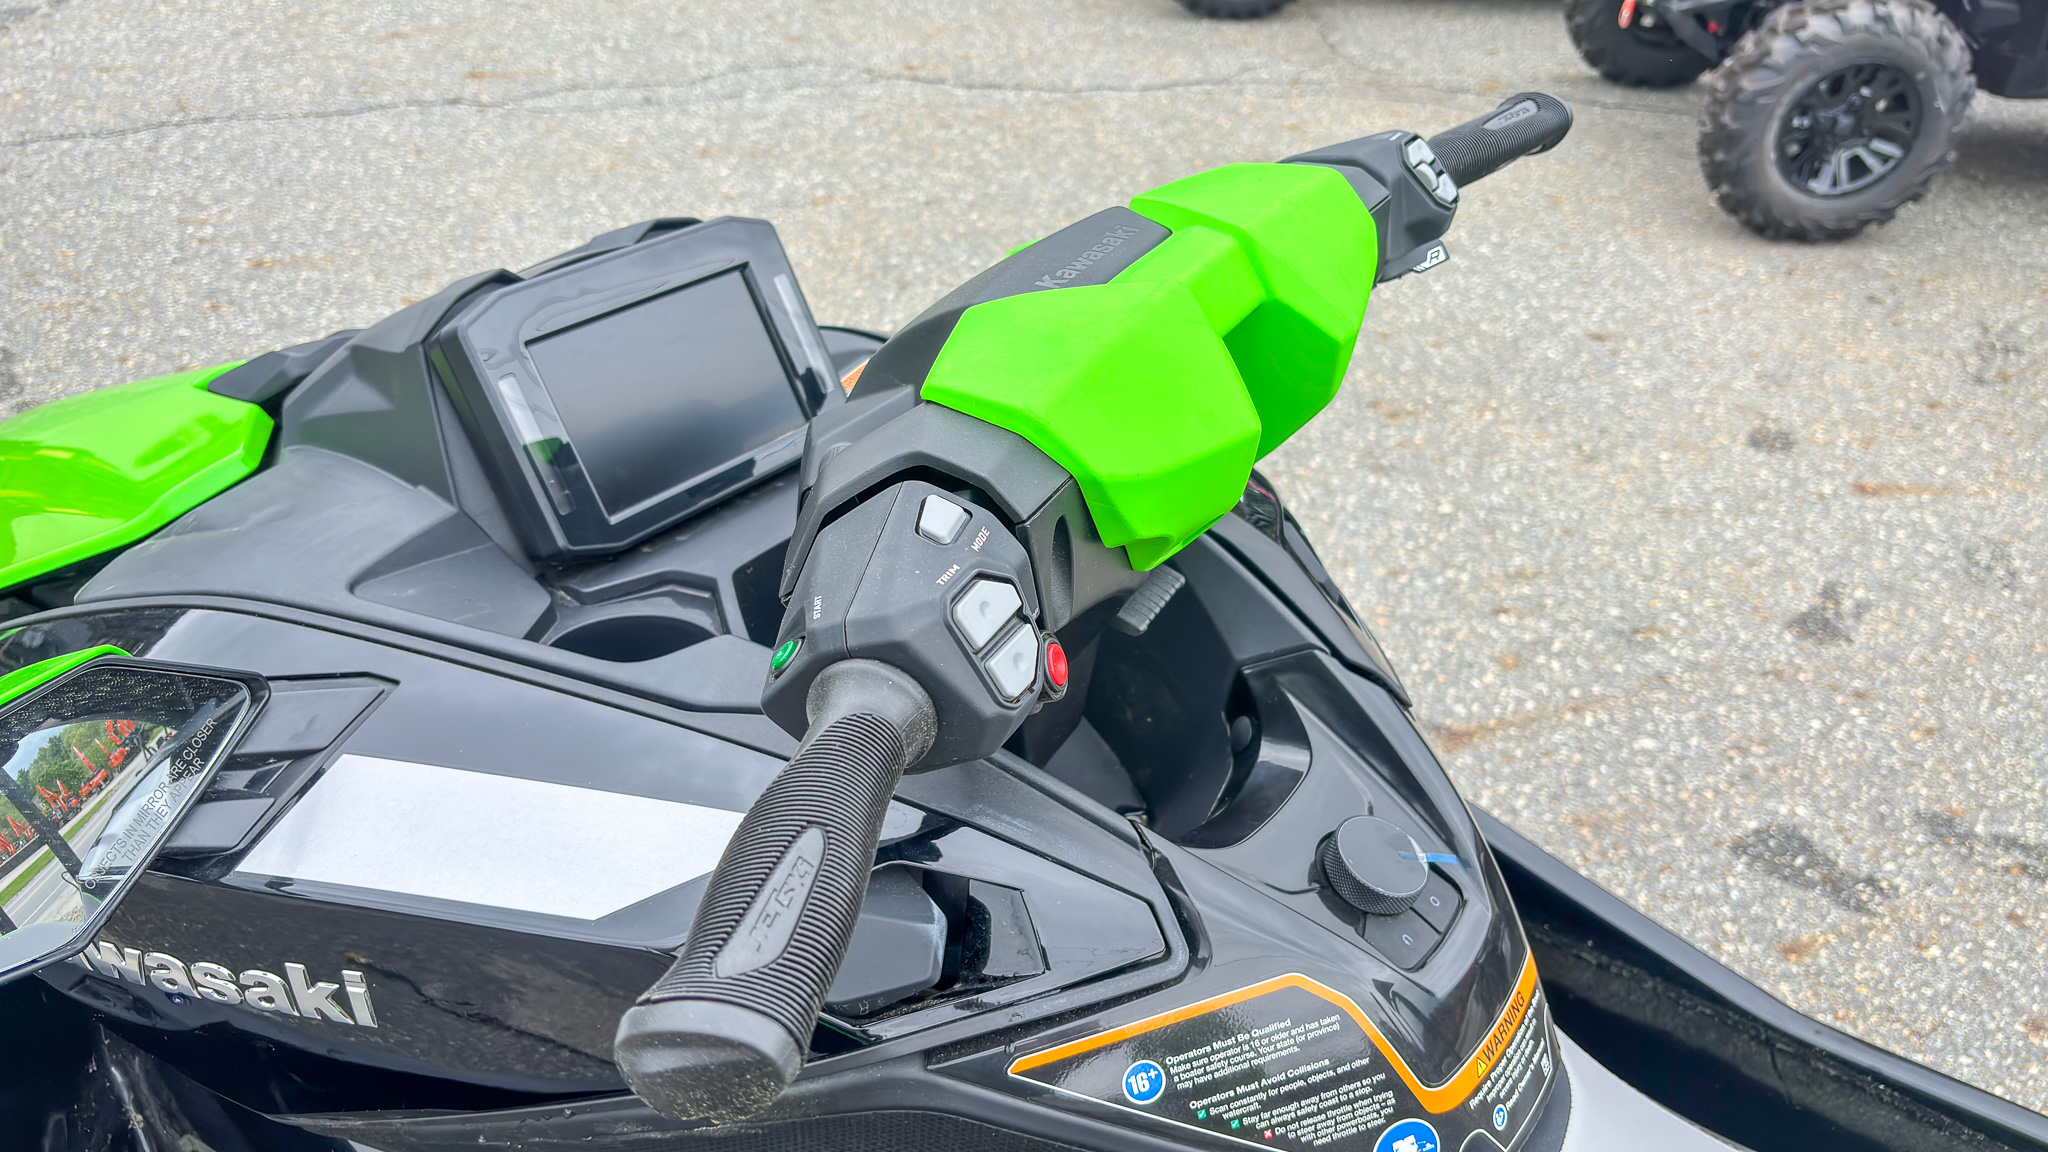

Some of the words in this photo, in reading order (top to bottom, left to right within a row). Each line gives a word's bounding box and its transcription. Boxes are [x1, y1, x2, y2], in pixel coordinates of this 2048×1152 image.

[1034, 223, 1140, 289] Kawasaki
[970, 525, 991, 553] MODE
[935, 563, 960, 587] TRIM
[812, 594, 823, 621] START
[85, 837, 128, 889] OBJECTS
[123, 824, 138, 840] IN
[132, 781, 169, 825] MIRROR
[166, 758, 188, 785] ARE
[183, 717, 218, 761] CLOSER
[121, 831, 151, 863] THAN
[145, 799, 172, 831] THEY
[170, 757, 205, 803] APPEAR
[78, 940, 379, 1028] wasaki
[1165, 1046, 1210, 1065] Operators
[1212, 1036, 1236, 1050] Must
[1237, 1033, 1250, 1042] Be
[1251, 1018, 1291, 1037] Qualified
[1169, 1063, 1191, 1075] Make
[1192, 1057, 1209, 1067] sure
[1209, 1046, 1241, 1062] operator
[1242, 1043, 1250, 1051] is
[1249, 1039, 1260, 1048] 16
[1261, 1037, 1269, 1045] or
[1270, 1031, 1289, 1042] older
[1290, 1024, 1305, 1035] and
[1305, 1021, 1319, 1031] has
[1319, 1014, 1340, 1026] taken
[1482, 991, 1525, 1062] WARNING
[1177, 1079, 1193, 1090] may
[1194, 1073, 1213, 1084] have
[1213, 1061, 1250, 1077] additional
[1250, 1044, 1300, 1066] requirements.
[1179, 1067, 1204, 1080] boater
[1205, 1059, 1228, 1072] safety
[1229, 1049, 1257, 1064] course.
[1257, 1044, 1275, 1055] Your
[1276, 1038, 1295, 1049] state
[1295, 1034, 1305, 1043] (or
[1307, 1022, 1340, 1040] province)
[1469, 1080, 1492, 1110] Require
[1490, 1056, 1507, 1082] Proper
[1506, 1022, 1526, 1058] Operation
[1127, 1068, 1159, 1095] 16+
[1189, 1090, 1235, 1109] Operators
[1236, 1081, 1259, 1095] Must
[1261, 1071, 1286, 1087] Avoid
[1287, 1059, 1330, 1077] Collisions
[1209, 1104, 1229, 1116] Scan
[1229, 1091, 1267, 1110] constantly
[1268, 1088, 1278, 1097] for
[1279, 1079, 1307, 1095] people,
[1307, 1070, 1336, 1084] objects,
[1336, 1063, 1351, 1074] and
[1351, 1057, 1369, 1069] other
[1242, 1115, 1259, 1126] Stay
[1260, 1111, 1271, 1120] far
[1272, 1101, 1300, 1117] enough
[1300, 1095, 1319, 1107] away
[1320, 1089, 1338, 1100] from
[1338, 1081, 1362, 1094] others
[1362, 1078, 1371, 1086] so
[1372, 1072, 1386, 1084] you
[1505, 1090, 1520, 1111] Read
[1222, 1102, 1261, 1120] watercraft.
[1255, 1120, 1270, 1130] can
[1270, 1110, 1296, 1125] always
[1296, 1104, 1318, 1116] safely
[1317, 1096, 1339, 1109] coast
[1339, 1094, 1348, 1102] to
[1354, 1086, 1373, 1097] stop.
[1274, 1127, 1286, 1135] Do
[1287, 1121, 1300, 1131] not
[1300, 1113, 1326, 1127] release
[1326, 1104, 1352, 1118] throttle
[1353, 1097, 1372, 1109] when
[1373, 1090, 1394, 1105] trying
[1287, 1131, 1296, 1139] to
[1297, 1123, 1315, 1136] steer
[1316, 1118, 1335, 1130] away
[1336, 1112, 1354, 1123] from
[1354, 1103, 1381, 1118] objects
[1387, 1097, 1396, 1106] as
[1299, 1132, 1316, 1143] with
[1317, 1124, 1336, 1137] other
[1336, 1112, 1381, 1132] powerboats,
[1380, 1106, 1394, 1117] you
[1312, 1134, 1332, 1146] need
[1330, 1126, 1357, 1140] throttle
[1358, 1124, 1366, 1132] to
[1365, 1115, 1386, 1129] steer.
